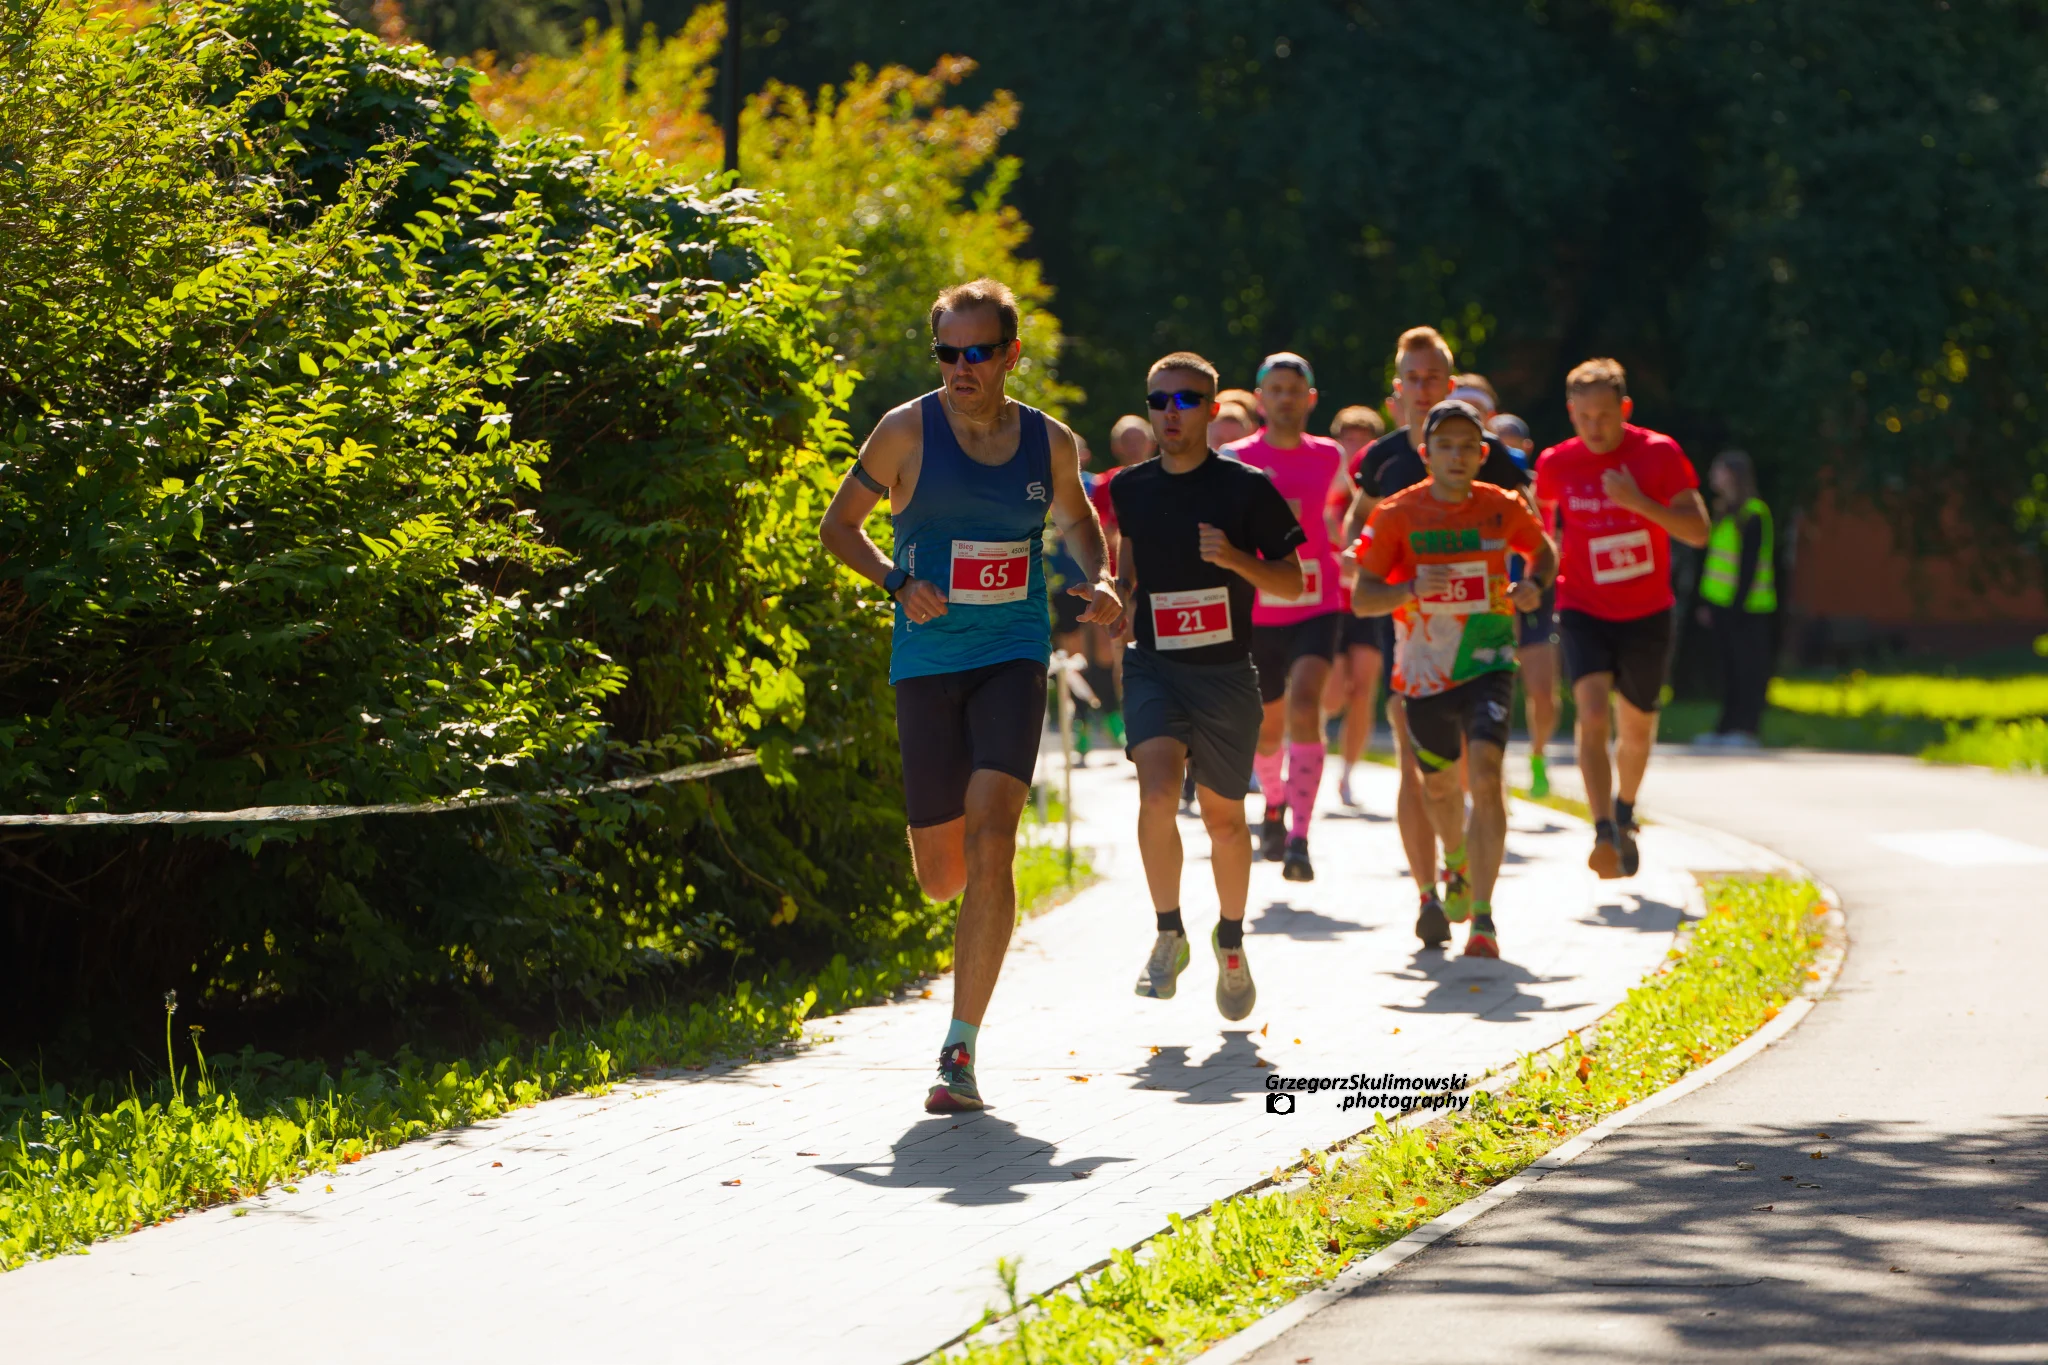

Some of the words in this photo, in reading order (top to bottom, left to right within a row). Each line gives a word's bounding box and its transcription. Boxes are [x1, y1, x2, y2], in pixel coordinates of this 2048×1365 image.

[958, 543, 974, 551] Bieg
[1011, 547, 1025, 555] 4500
[979, 562, 1009, 588] 65
[1176, 609, 1207, 633] 21
